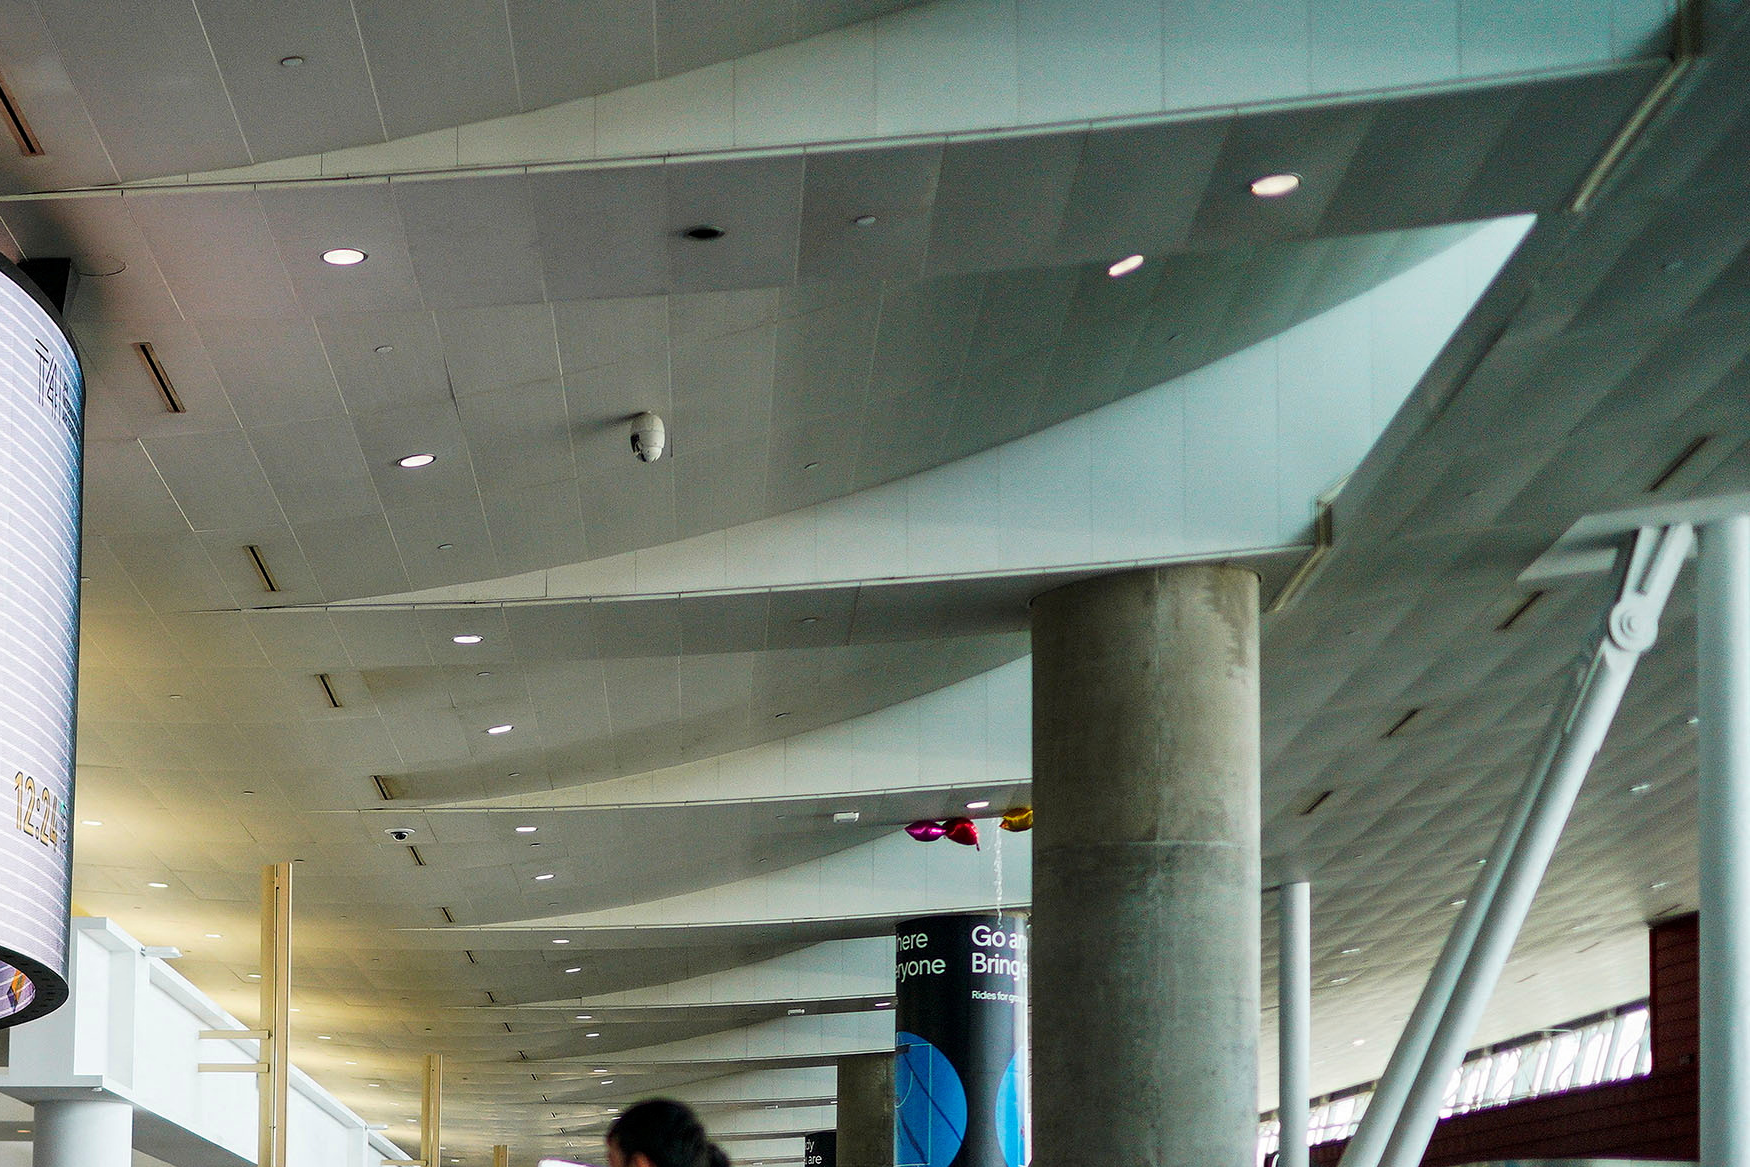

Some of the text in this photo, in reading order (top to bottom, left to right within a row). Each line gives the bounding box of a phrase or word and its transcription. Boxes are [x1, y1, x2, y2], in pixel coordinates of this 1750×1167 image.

[972, 925, 1006, 947] Go
[972, 990, 996, 1000] Rides
[997, 991, 1008, 1000] for
